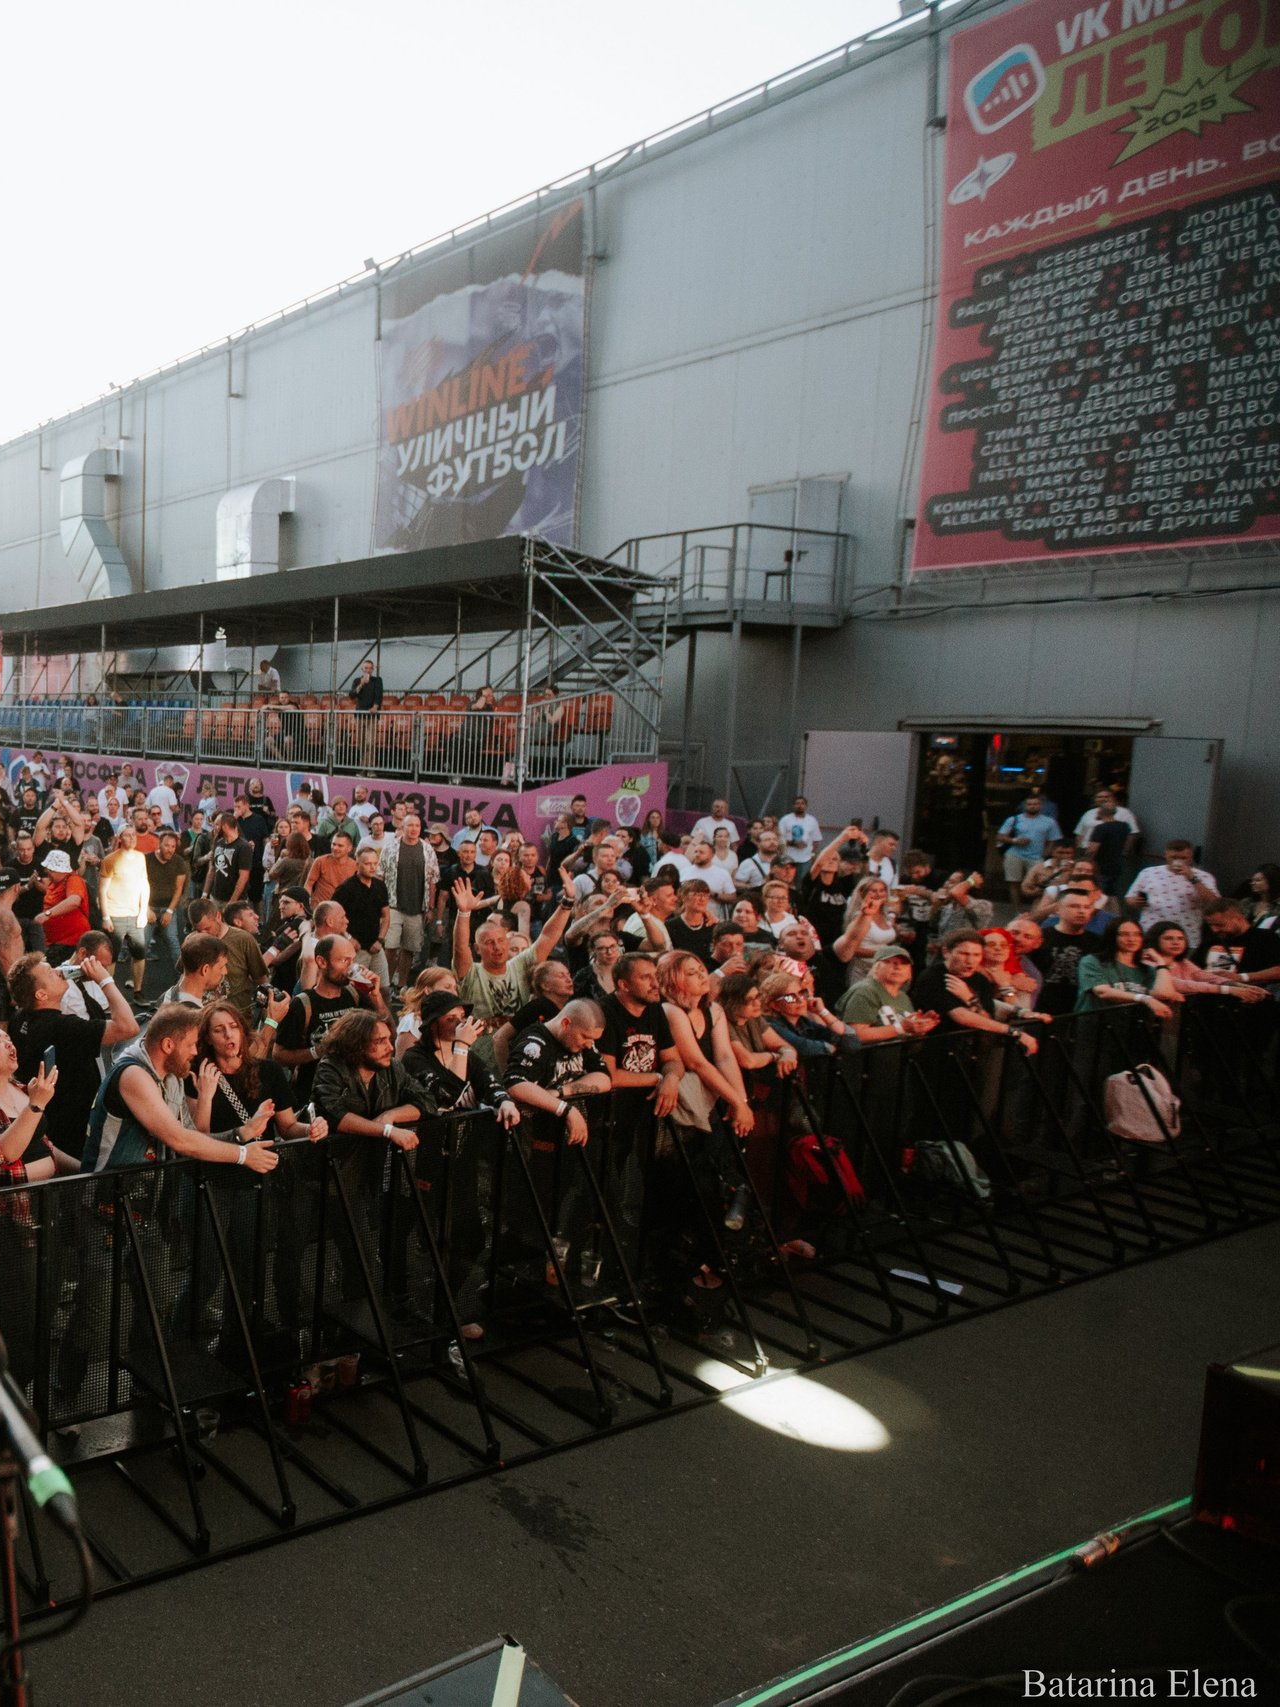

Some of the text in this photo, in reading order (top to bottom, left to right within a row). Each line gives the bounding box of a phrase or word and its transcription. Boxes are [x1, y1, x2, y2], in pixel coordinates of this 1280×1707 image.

[1056, 1, 1111, 55] VK
[1051, 0, 1280, 128] ЛЕТО
[1144, 94, 1217, 134] 2025
[963, 185, 1109, 248] КАЖДЫЙ
[1118, 158, 1227, 203] ДЕНЬ.
[1186, 194, 1275, 229] ЛОЛИТА
[1177, 211, 1258, 245] СЕРГЕЙ
[1201, 229, 1257, 255] ВИТЯ
[1036, 228, 1151, 270] ICEGERGERT
[1132, 252, 1171, 272] TGK
[1008, 245, 1147, 292] VOSKRESENSKII
[1126, 252, 1219, 289] ЕВГЕНИЙ
[1049, 285, 1099, 309] СВИК
[1117, 267, 1226, 305] OBLADAET
[1146, 285, 1219, 313] NKEEEI
[956, 296, 1007, 319] РАСУЛ
[1192, 289, 1267, 318] SALUKI
[988, 310, 1058, 338] АНТОХА
[1002, 316, 1084, 348] FORTUNA
[1061, 313, 1162, 347] SHILOVETS
[1104, 308, 1250, 351] PEPEL NAHUDI
[1151, 332, 1212, 356] HAON
[960, 346, 1079, 383] UGLYSTEPHAN
[990, 366, 1051, 390] BEWHY
[1108, 346, 1221, 379] KAI ANGEL
[386, 342, 535, 446] WINLINE
[997, 374, 1083, 400] SODA LUV
[1086, 370, 1171, 399] ДЖИЗУС
[947, 401, 1014, 424] ПРОСТО
[1016, 383, 1177, 424] ПАВЕЛ ДЕДИЩЕВ
[1174, 397, 1274, 425] BIG BABY
[396, 366, 557, 477] УЛИЧНЫЙ
[985, 399, 1176, 443] ТИМА БЕЛОРУССКИХ
[1140, 412, 1280, 445] КОСТА ЛАКО
[980, 420, 1140, 457] CALL ME KARIZMA
[988, 439, 1111, 469] LIL KRYSTALLL
[1113, 432, 1247, 463] СЛАВА КПСС
[427, 421, 567, 499] ФУТБОЛ
[978, 457, 1087, 483] INSTASAMKA
[1134, 443, 1280, 475] HERONWATER
[1024, 467, 1107, 490] MARY GU
[1131, 466, 1229, 490] FRIENDLY
[932, 482, 1104, 516] КОМНАТА КУЛЬТУРЫ
[1048, 486, 1184, 514] DEAD BLONDE
[1146, 493, 1254, 517] СЮЗАННА
[941, 508, 1000, 526] ALBLAK
[1012, 508, 1119, 532] SQWOZ BAB
[1055, 509, 1241, 541] И МНОГИЕ ДРУГИЕ
